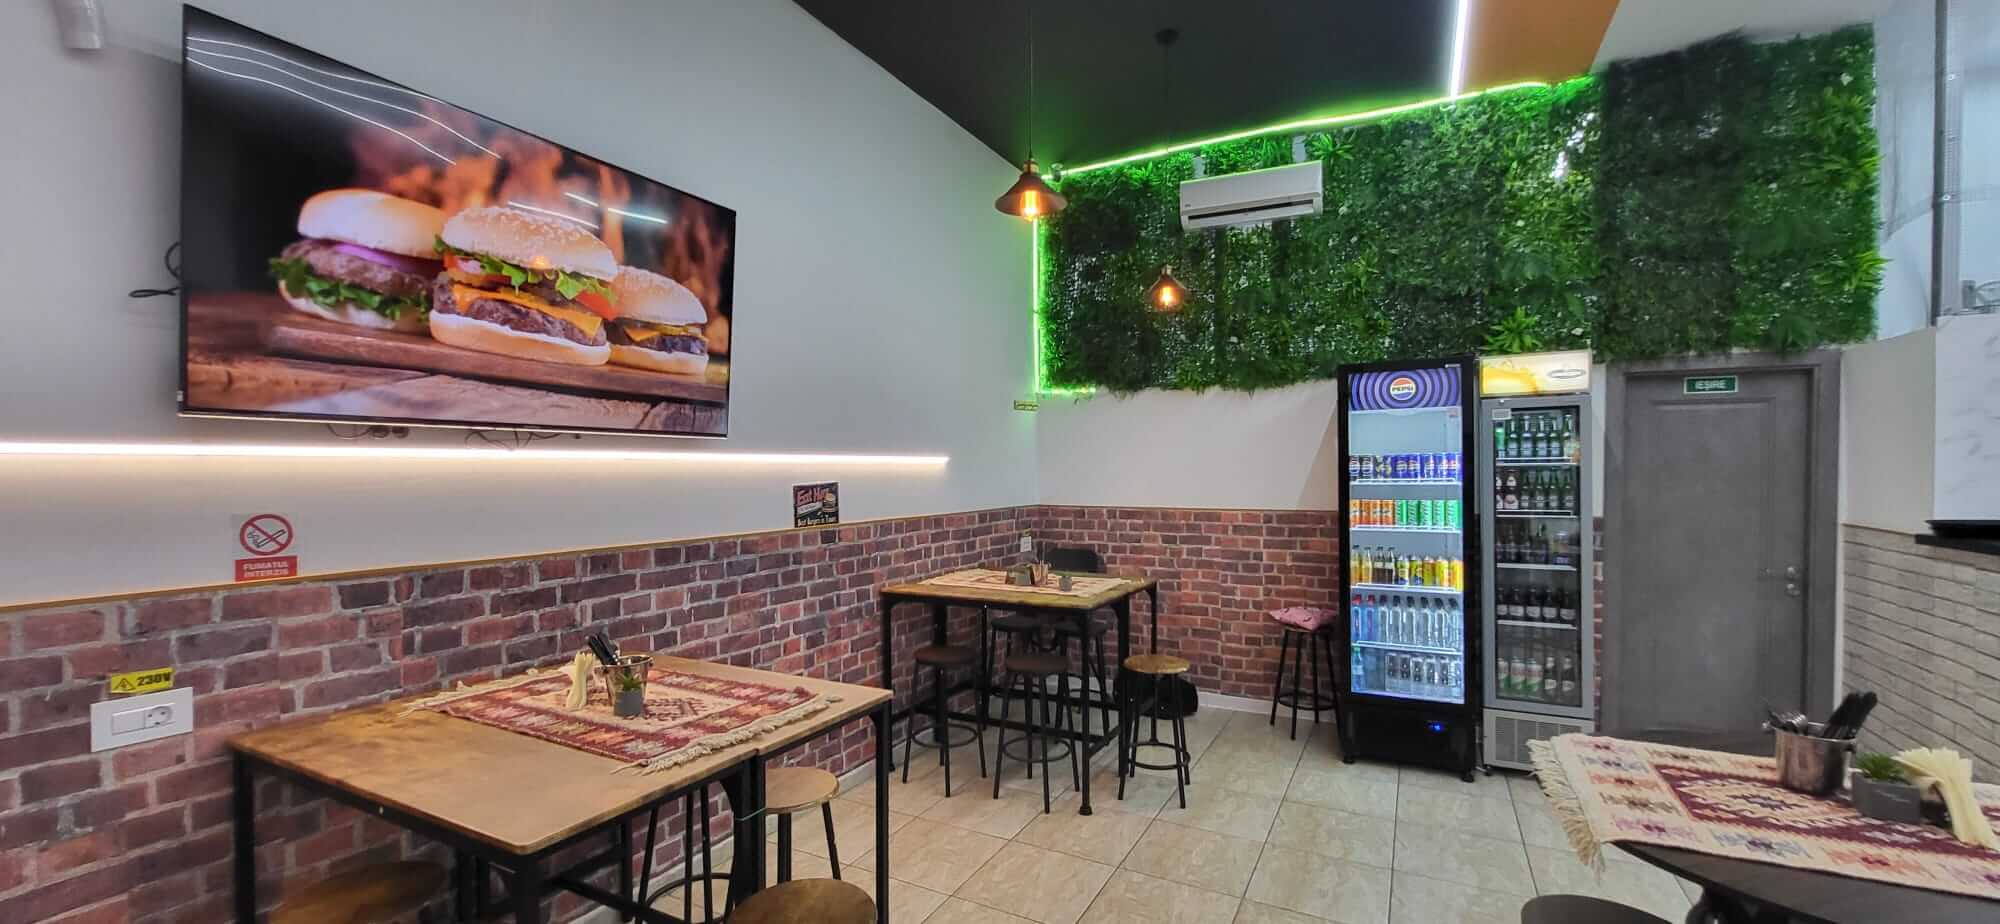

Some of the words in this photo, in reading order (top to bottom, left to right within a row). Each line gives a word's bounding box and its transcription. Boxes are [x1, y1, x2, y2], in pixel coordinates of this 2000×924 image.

[797, 489, 813, 507] Eat
[243, 561, 289, 572] FUMATUL
[243, 569, 289, 579] INTERZIS
[136, 673, 171, 686] 230V
